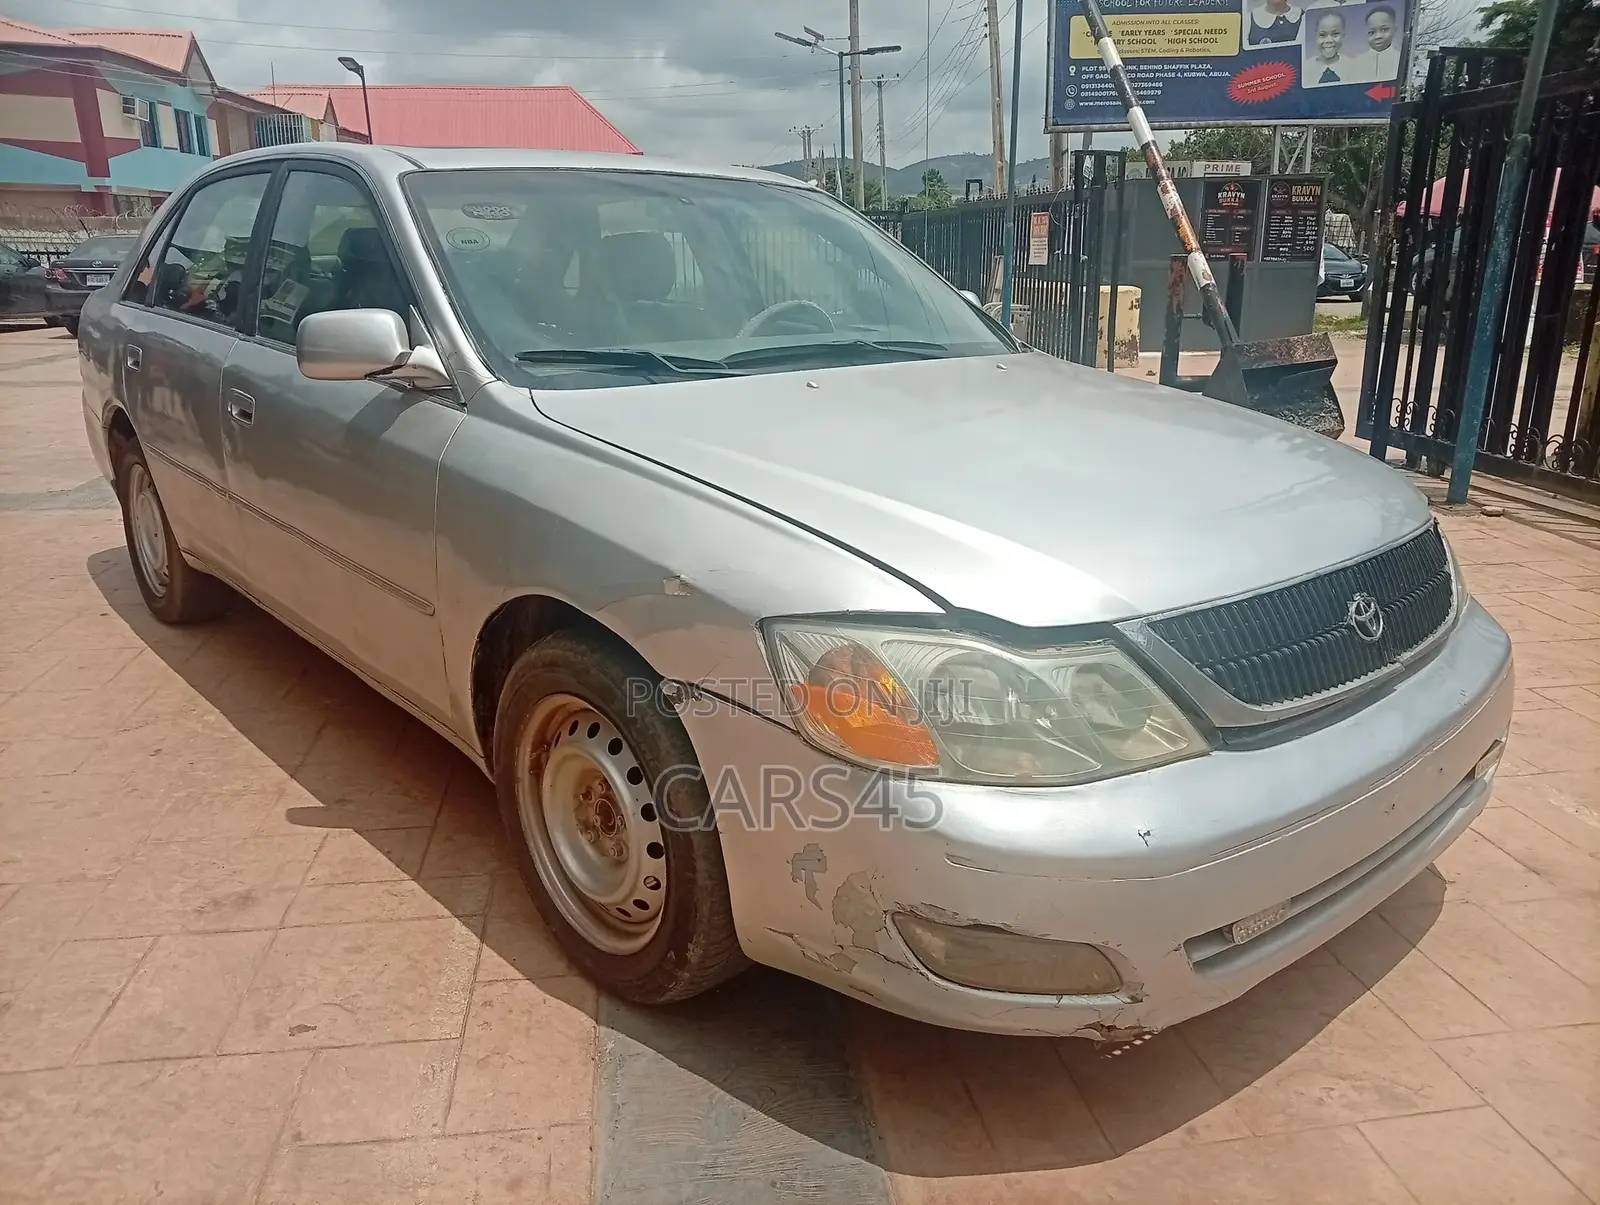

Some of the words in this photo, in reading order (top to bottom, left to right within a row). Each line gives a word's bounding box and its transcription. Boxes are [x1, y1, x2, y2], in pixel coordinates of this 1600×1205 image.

[1237, 78, 1261, 88] SUMMER
[1261, 72, 1286, 83] SCHOOL
[1204, 163, 1242, 172] PRIME
[1217, 191, 1246, 199] KRAVYN
[1291, 185, 1322, 196] KRAVYN
